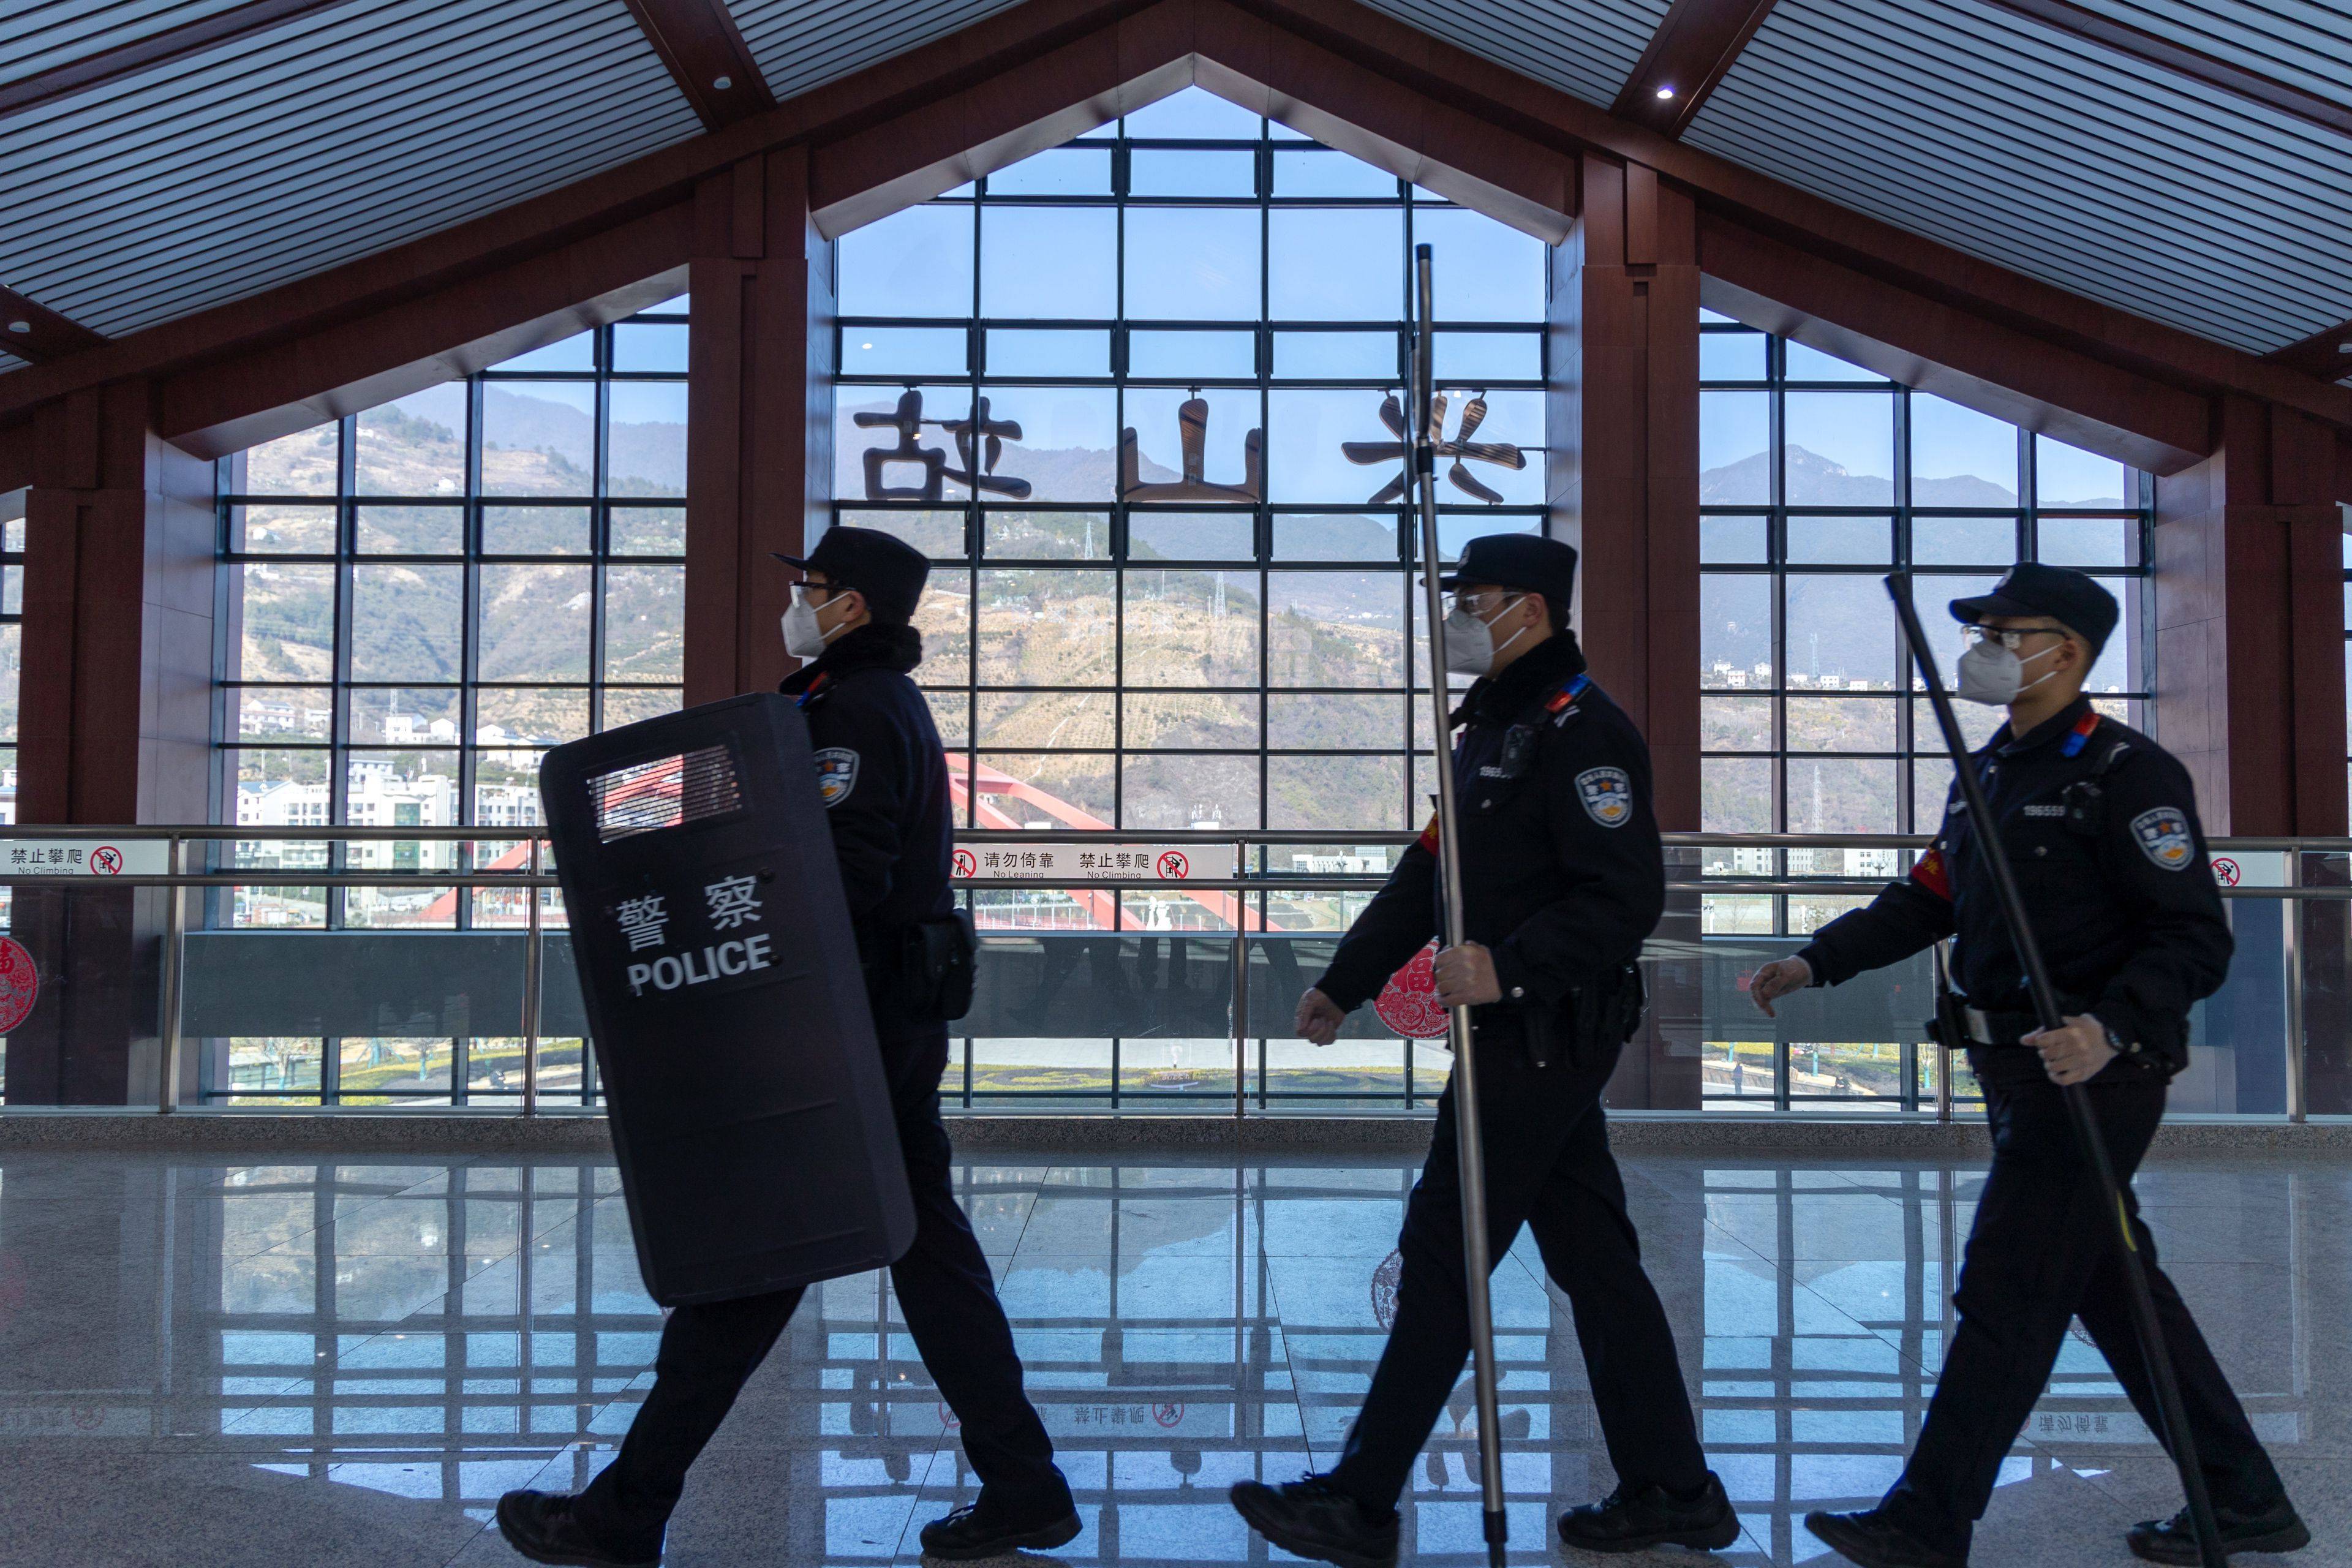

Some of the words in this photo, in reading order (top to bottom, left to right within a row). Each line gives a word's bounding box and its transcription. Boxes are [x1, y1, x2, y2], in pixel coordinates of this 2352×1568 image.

[11, 848, 82, 864] 禁止攀爬
[984, 852, 1054, 869] 请勿倚靠
[1080, 853, 1149, 869] 禁止攀爬
[617, 876, 763, 952] 警察
[627, 934, 771, 997] POLICE
